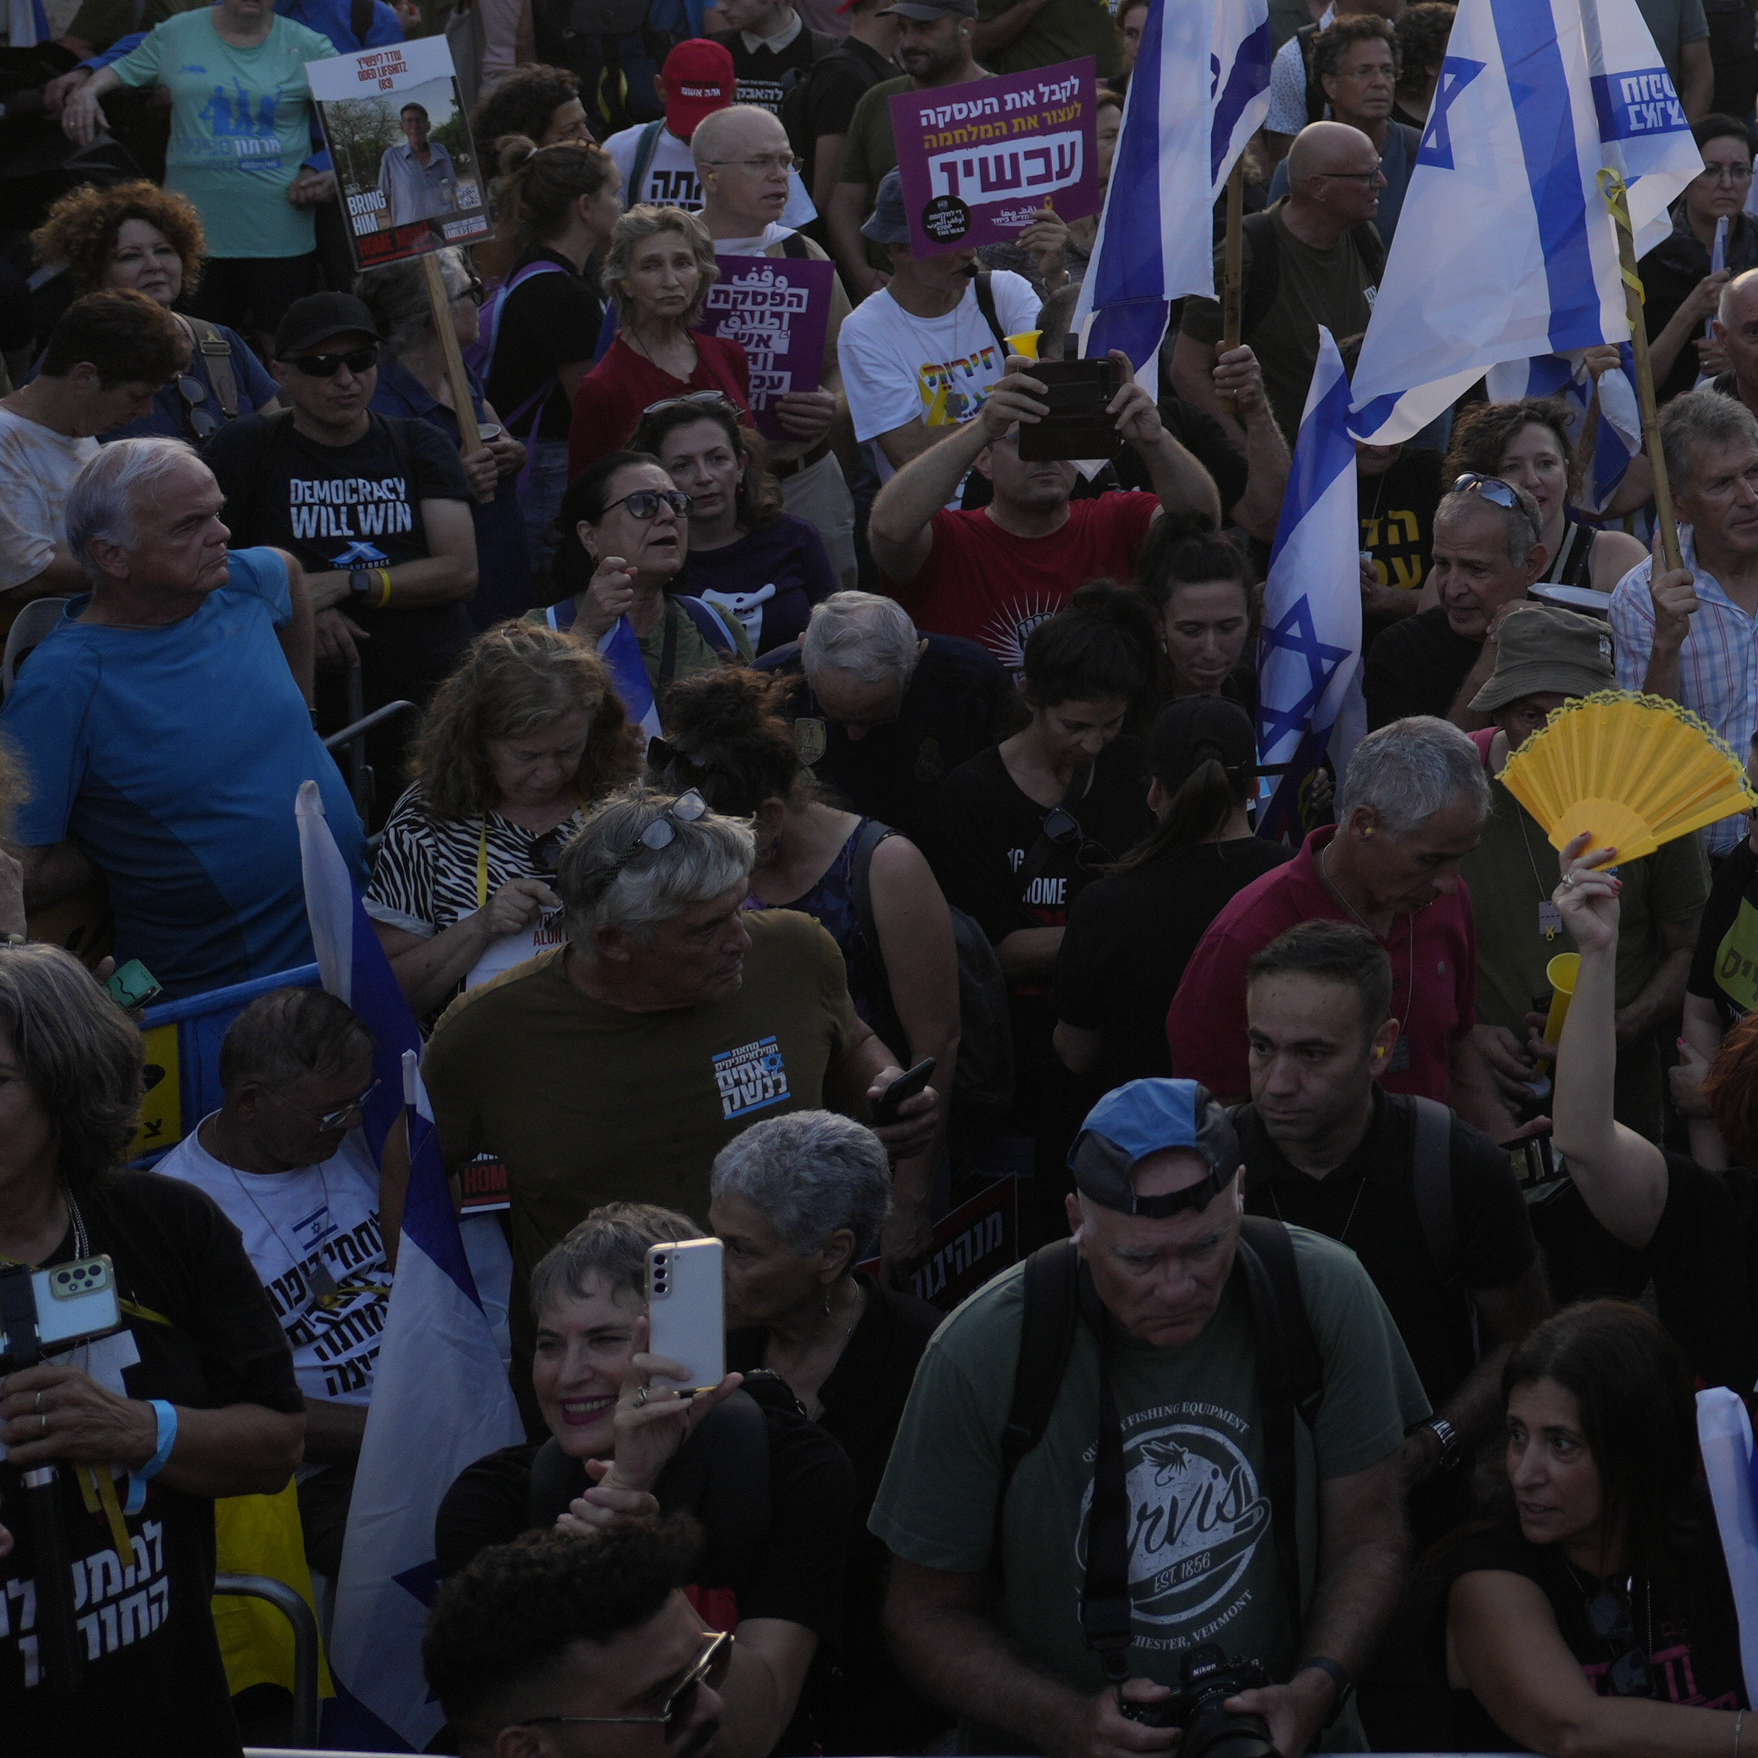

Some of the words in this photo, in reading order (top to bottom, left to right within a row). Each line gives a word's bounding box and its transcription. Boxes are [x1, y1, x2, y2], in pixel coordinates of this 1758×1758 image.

[358, 68, 378, 82] ODED
[681, 86, 703, 97] אשם
[704, 88, 721, 98] אתה
[736, 87, 784, 101] להאבק
[1003, 90, 1035, 109] את
[1036, 77, 1080, 109] לקבל
[920, 94, 999, 129] העסקה
[1038, 103, 1083, 129] לעצור
[923, 120, 1008, 150] המלחמה
[1012, 117, 1037, 135] את
[938, 138, 1078, 202] עכשיו
[347, 190, 388, 217] BRING
[351, 212, 380, 237] HIM
[711, 289, 805, 311] הפסקת
[289, 478, 407, 505] DEMOCRACY
[290, 505, 355, 540] WILL
[356, 502, 414, 535] WIN
[731, 1042, 760, 1059] מחאת
[716, 1059, 767, 1091] אחים
[720, 1070, 789, 1118] לנשק
[463, 1165, 510, 1193] HOM
[1126, 1403, 1180, 1429] FISHING
[1181, 1401, 1249, 1434] EQUIPMENT
[1152, 1570, 1176, 1592] EST.
[1179, 1552, 1211, 1583] 1856
[1191, 1588, 1253, 1645] VERMONT
[1193, 1662, 1217, 1677] Nikon
